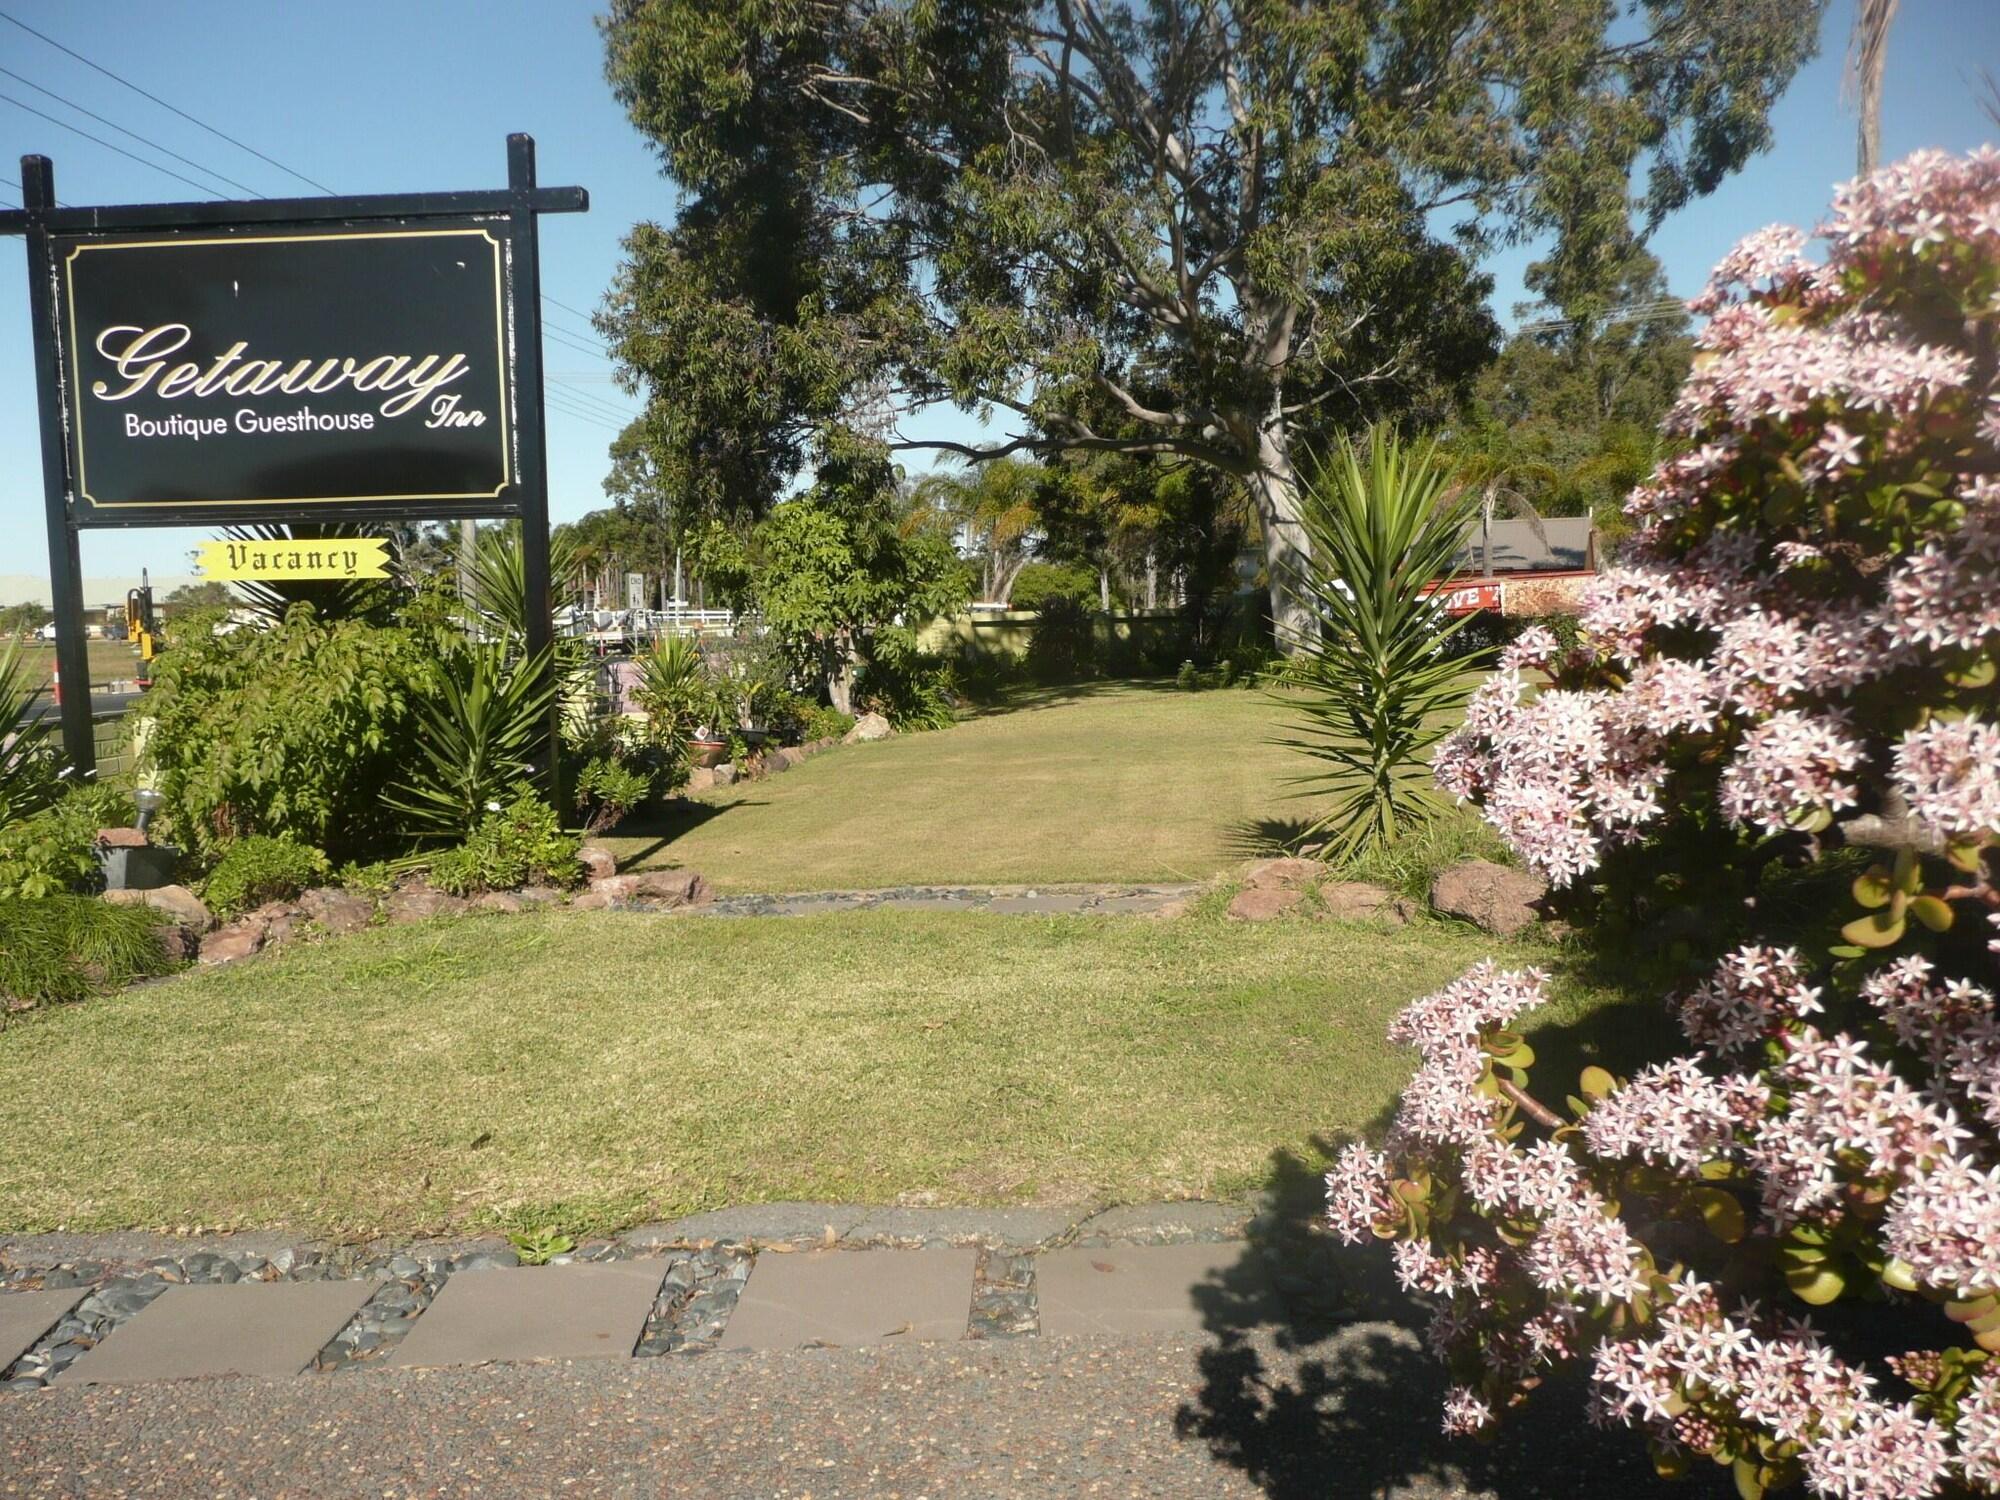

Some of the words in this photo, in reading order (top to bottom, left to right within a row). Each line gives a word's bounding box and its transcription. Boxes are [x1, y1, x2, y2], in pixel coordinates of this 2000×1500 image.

[92, 323, 470, 418] Getaway
[125, 413, 228, 441] Boutique
[235, 406, 375, 435] Guesthouse
[424, 394, 487, 429] Inn
[226, 543, 358, 578] Vacancy
